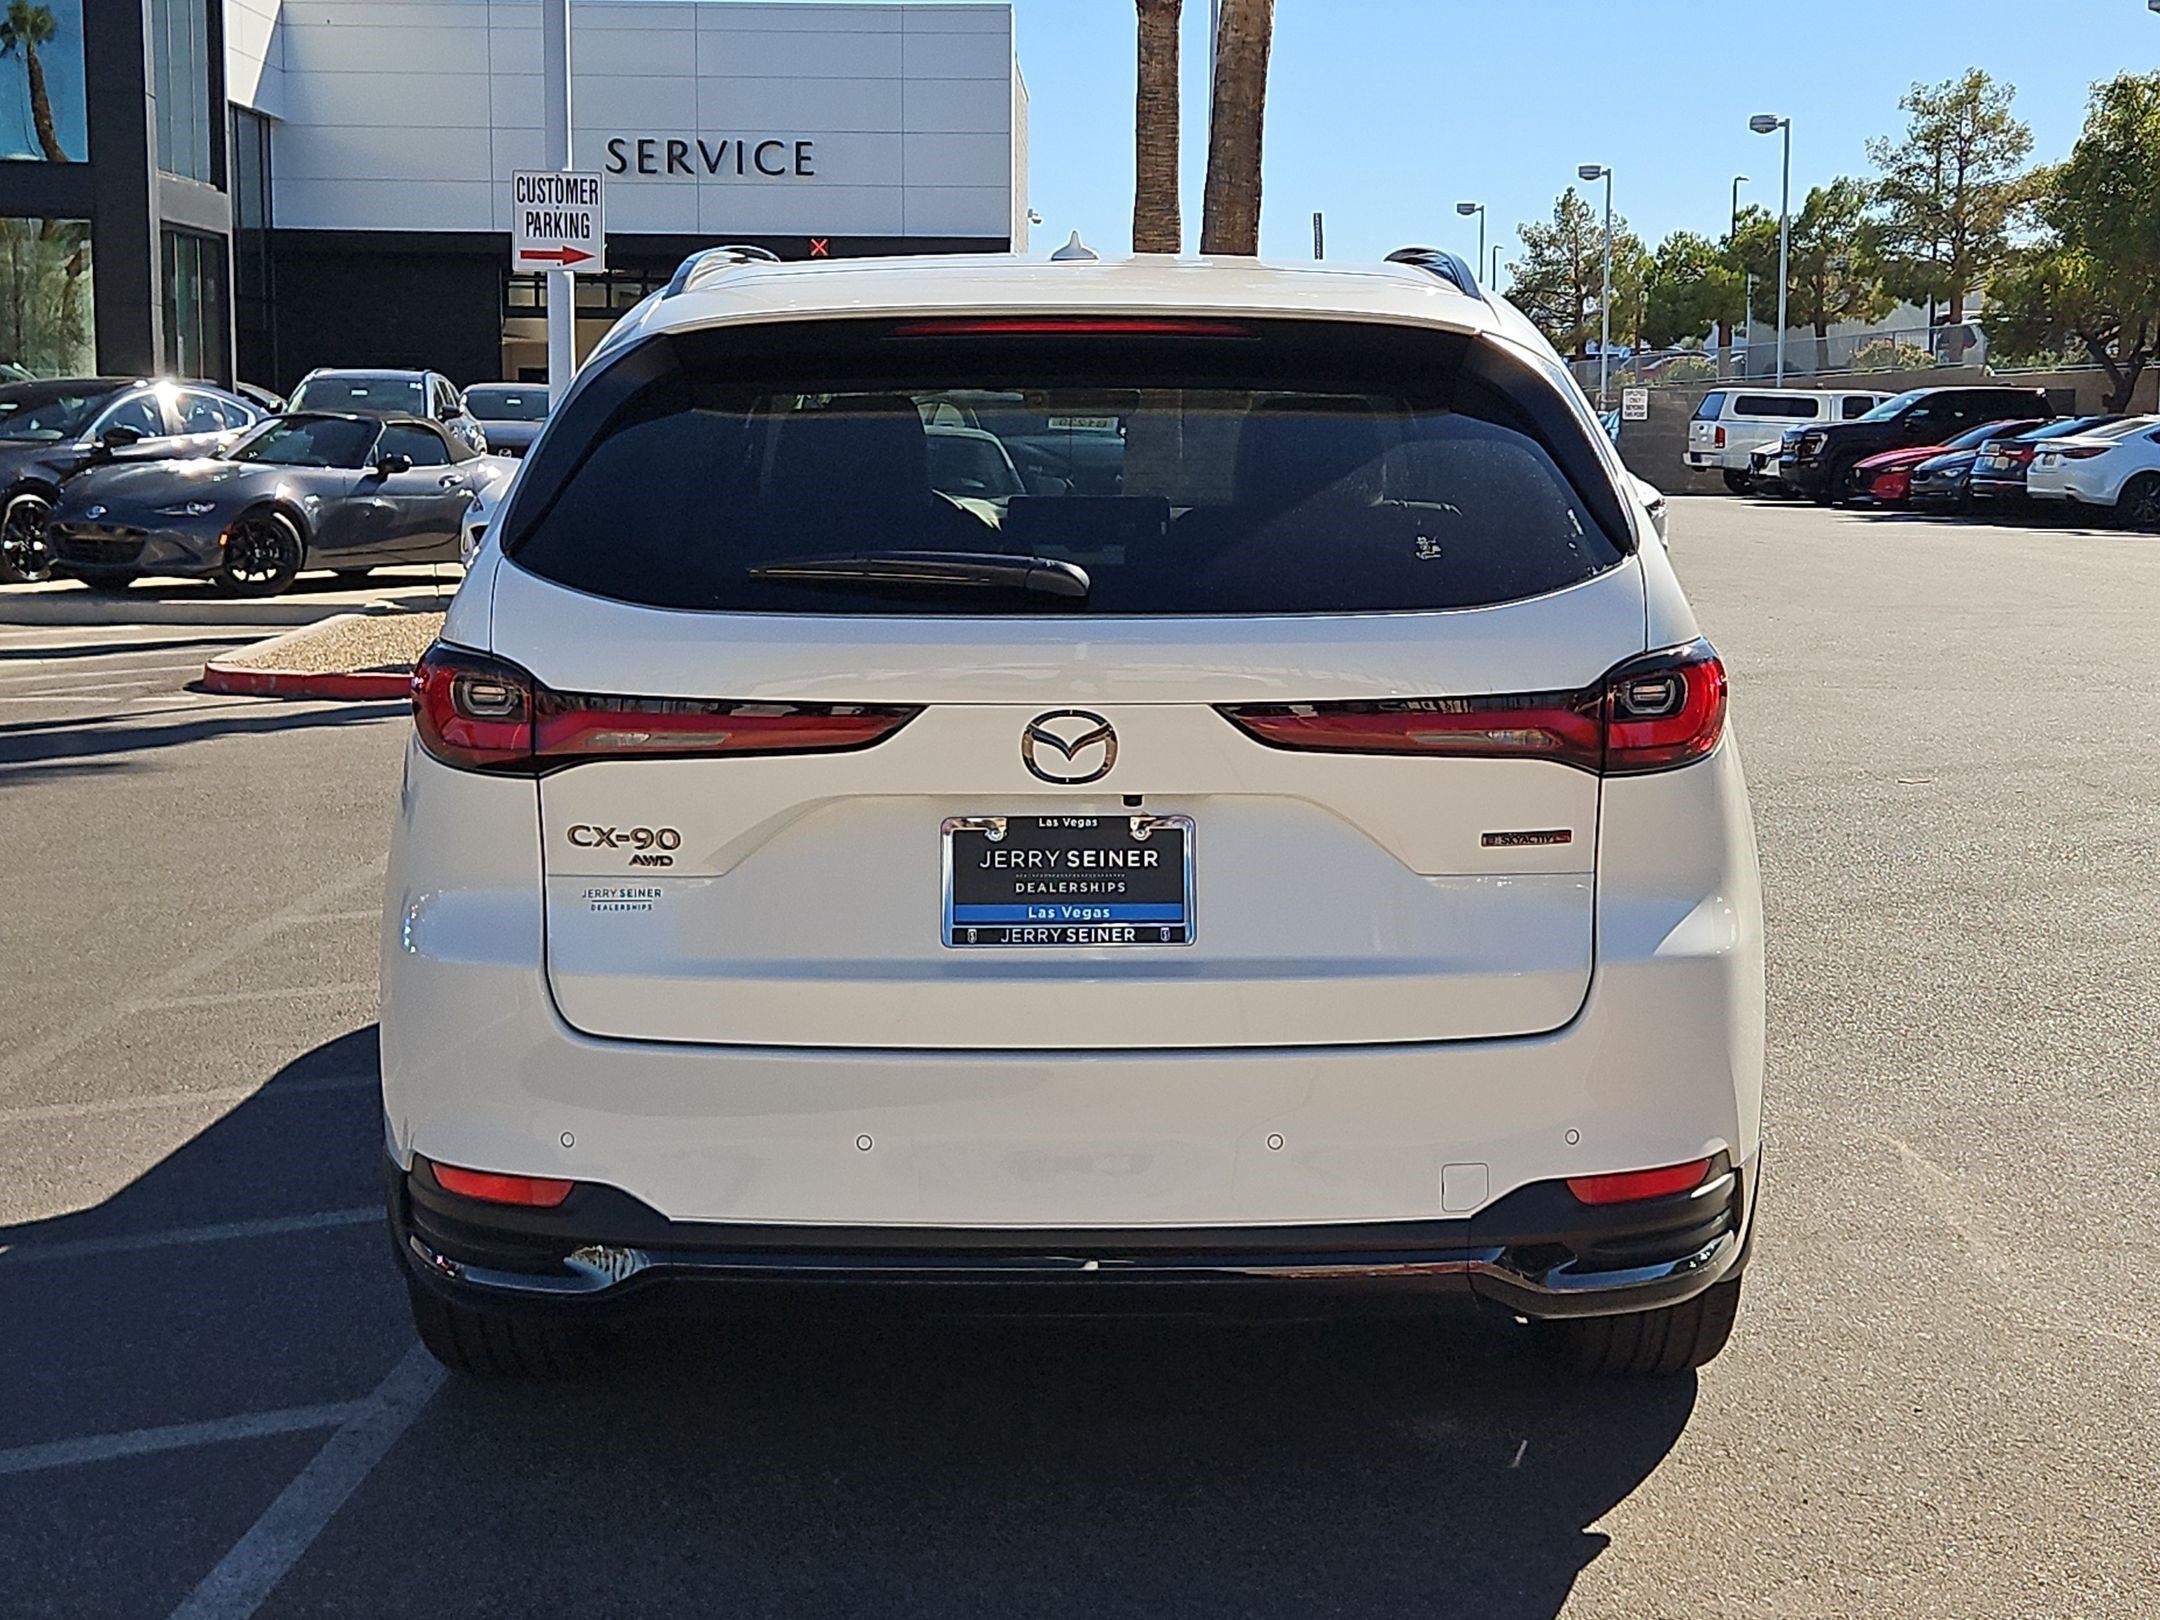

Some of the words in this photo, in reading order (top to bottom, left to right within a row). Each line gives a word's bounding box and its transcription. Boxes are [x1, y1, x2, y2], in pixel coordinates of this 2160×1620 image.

[605, 137, 816, 177] SERVICE
[516, 176, 599, 206] CUSTOMER
[525, 211, 590, 239] PARKING
[1039, 817, 1059, 827] Las
[1062, 817, 1098, 828] Vegas
[567, 824, 682, 851] CX-90
[628, 854, 674, 867] AWD
[979, 850, 1060, 868] JERRY
[1066, 850, 1159, 867] SEINER
[582, 889, 618, 898] JERRY
[619, 888, 662, 898] SEINER
[1015, 881, 1127, 893] DEALERSHIPS
[591, 903, 653, 912] DEALERSHIPS
[1028, 906, 1056, 919] Las
[1061, 906, 1111, 920] Vegas
[1000, 928, 1064, 943] JERRY
[1066, 927, 1136, 942] SEINER
